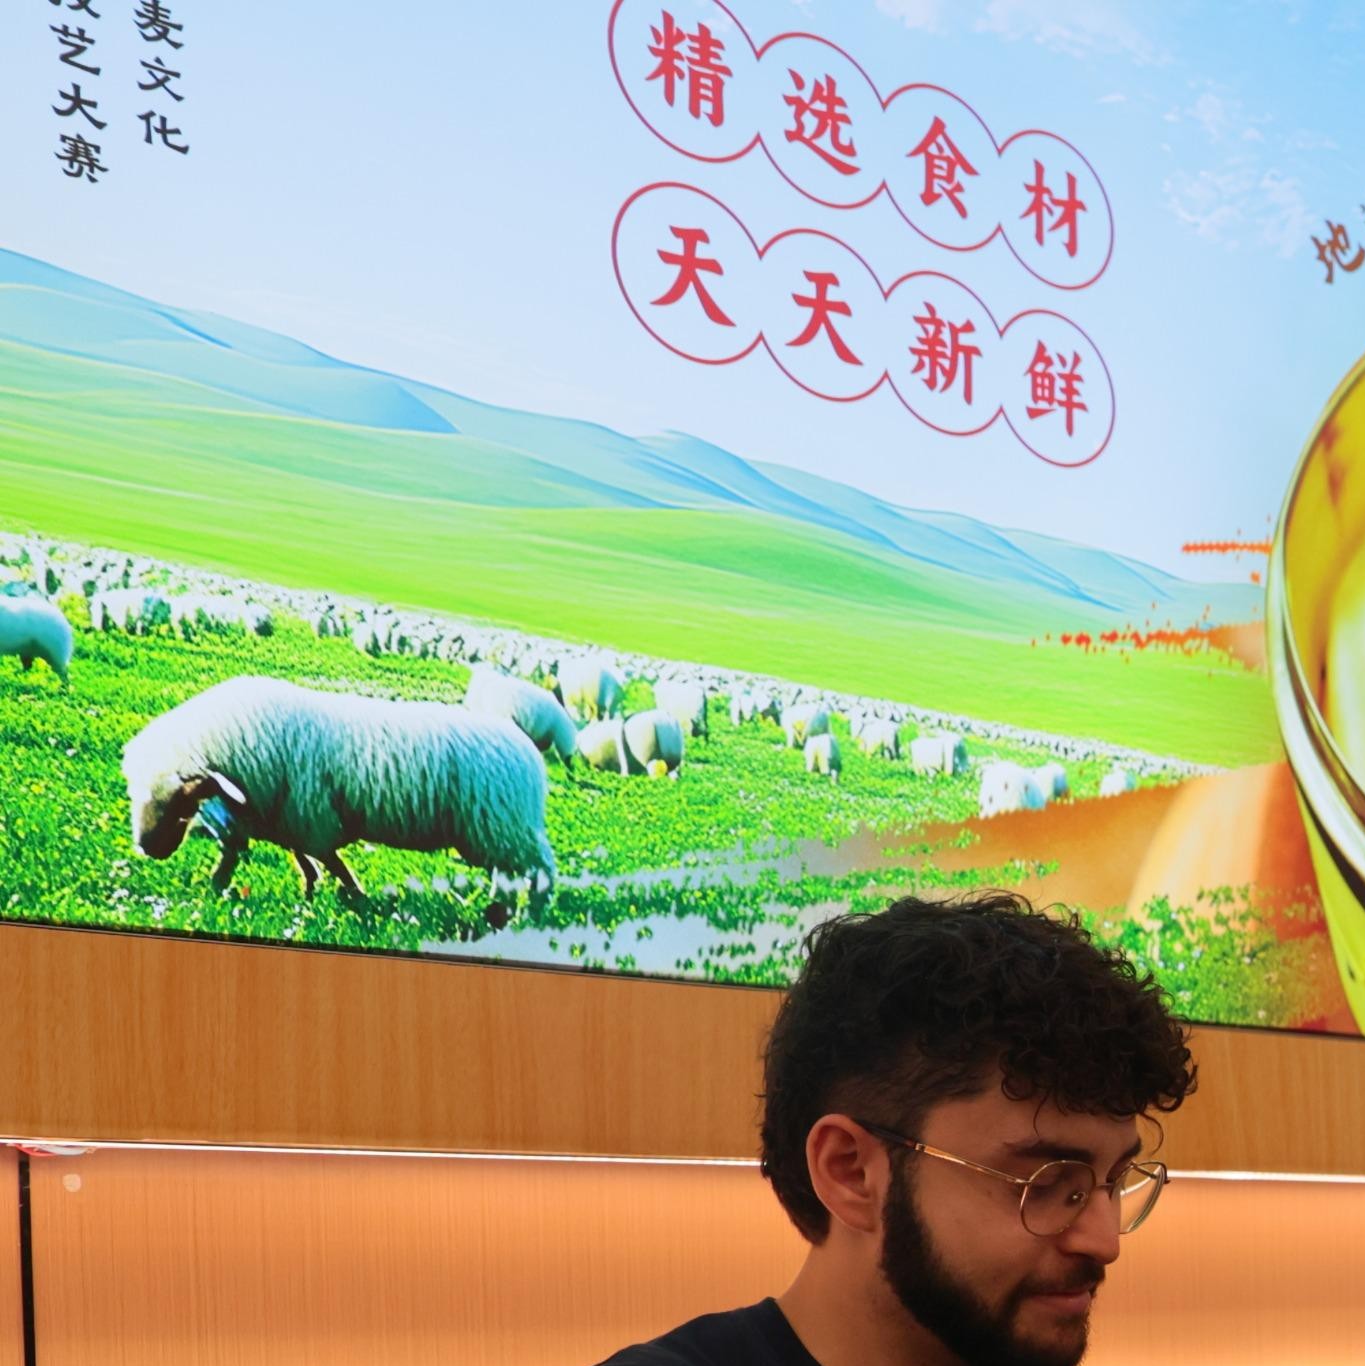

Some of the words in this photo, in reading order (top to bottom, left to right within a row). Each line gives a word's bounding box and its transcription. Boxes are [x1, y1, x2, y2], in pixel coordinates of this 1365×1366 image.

[644, 8, 1089, 259] 精选食材
[649, 224, 1089, 438] 天天新鲜
